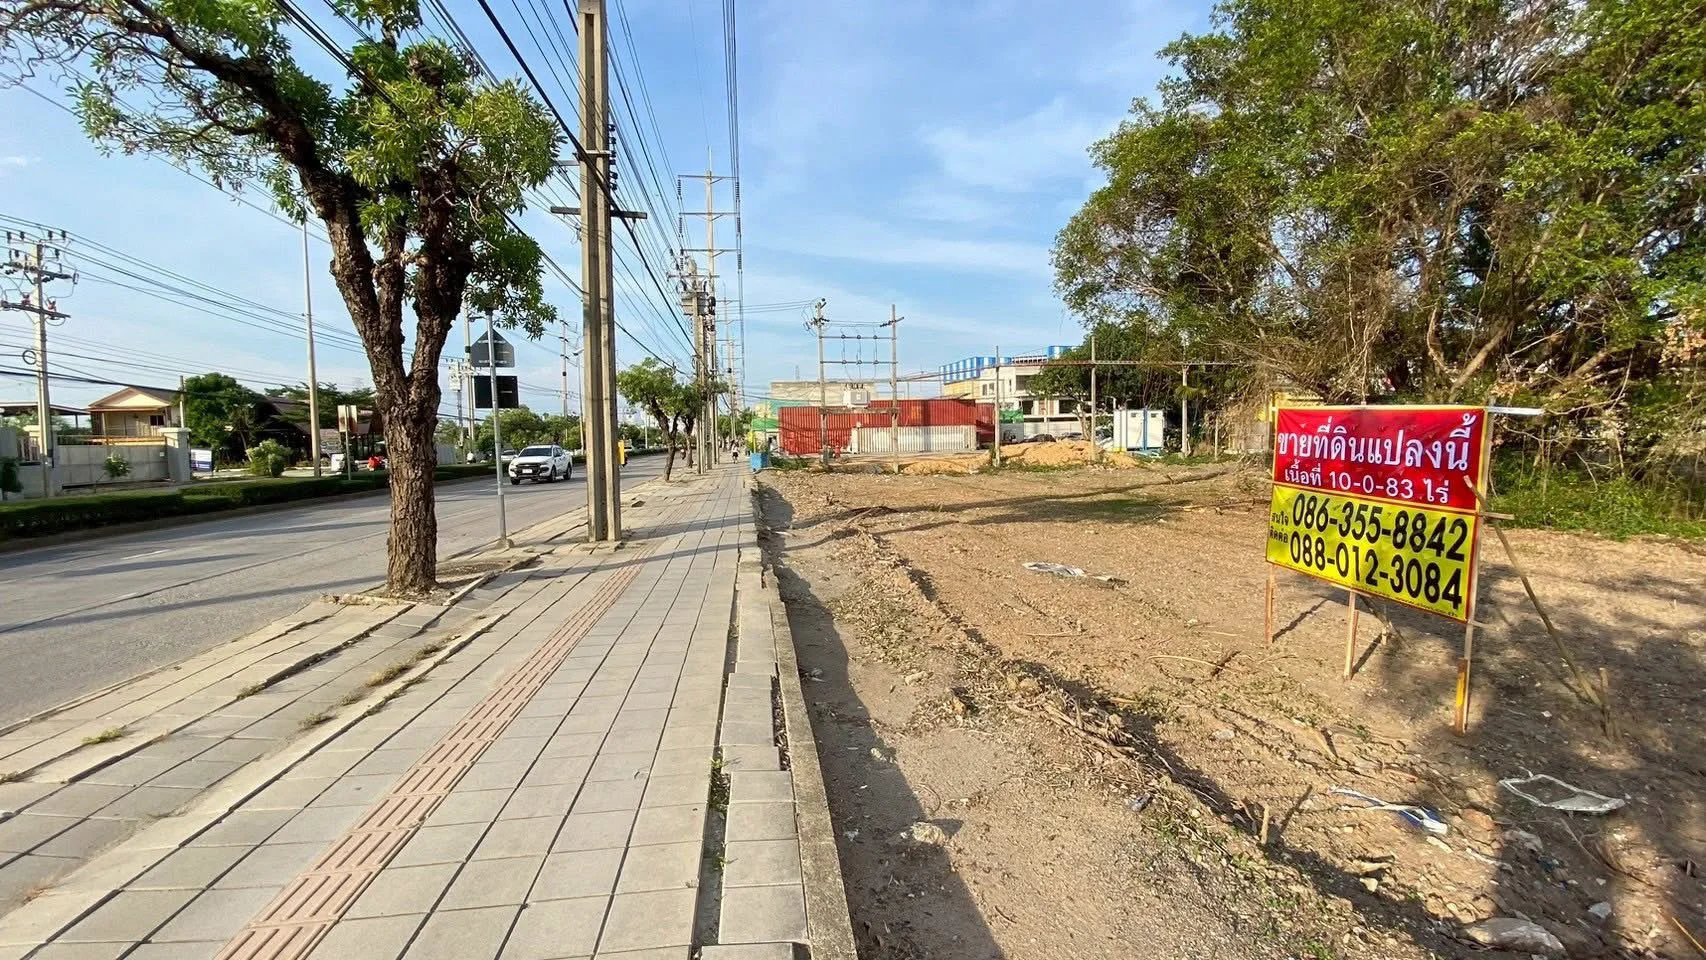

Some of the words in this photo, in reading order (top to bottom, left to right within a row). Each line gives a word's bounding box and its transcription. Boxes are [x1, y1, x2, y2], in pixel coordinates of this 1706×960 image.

[1277, 412, 1477, 471] ขายที่ดินแปลงนี้
[1284, 459, 1322, 487] เนื้อที่
[1329, 471, 1414, 499] 10-0-83
[1423, 478, 1449, 504] ไร่
[1271, 510, 1289, 526] สนใจ
[1292, 493, 1468, 563] 086-355-8842
[1290, 530, 1462, 610] 088-012-3084
